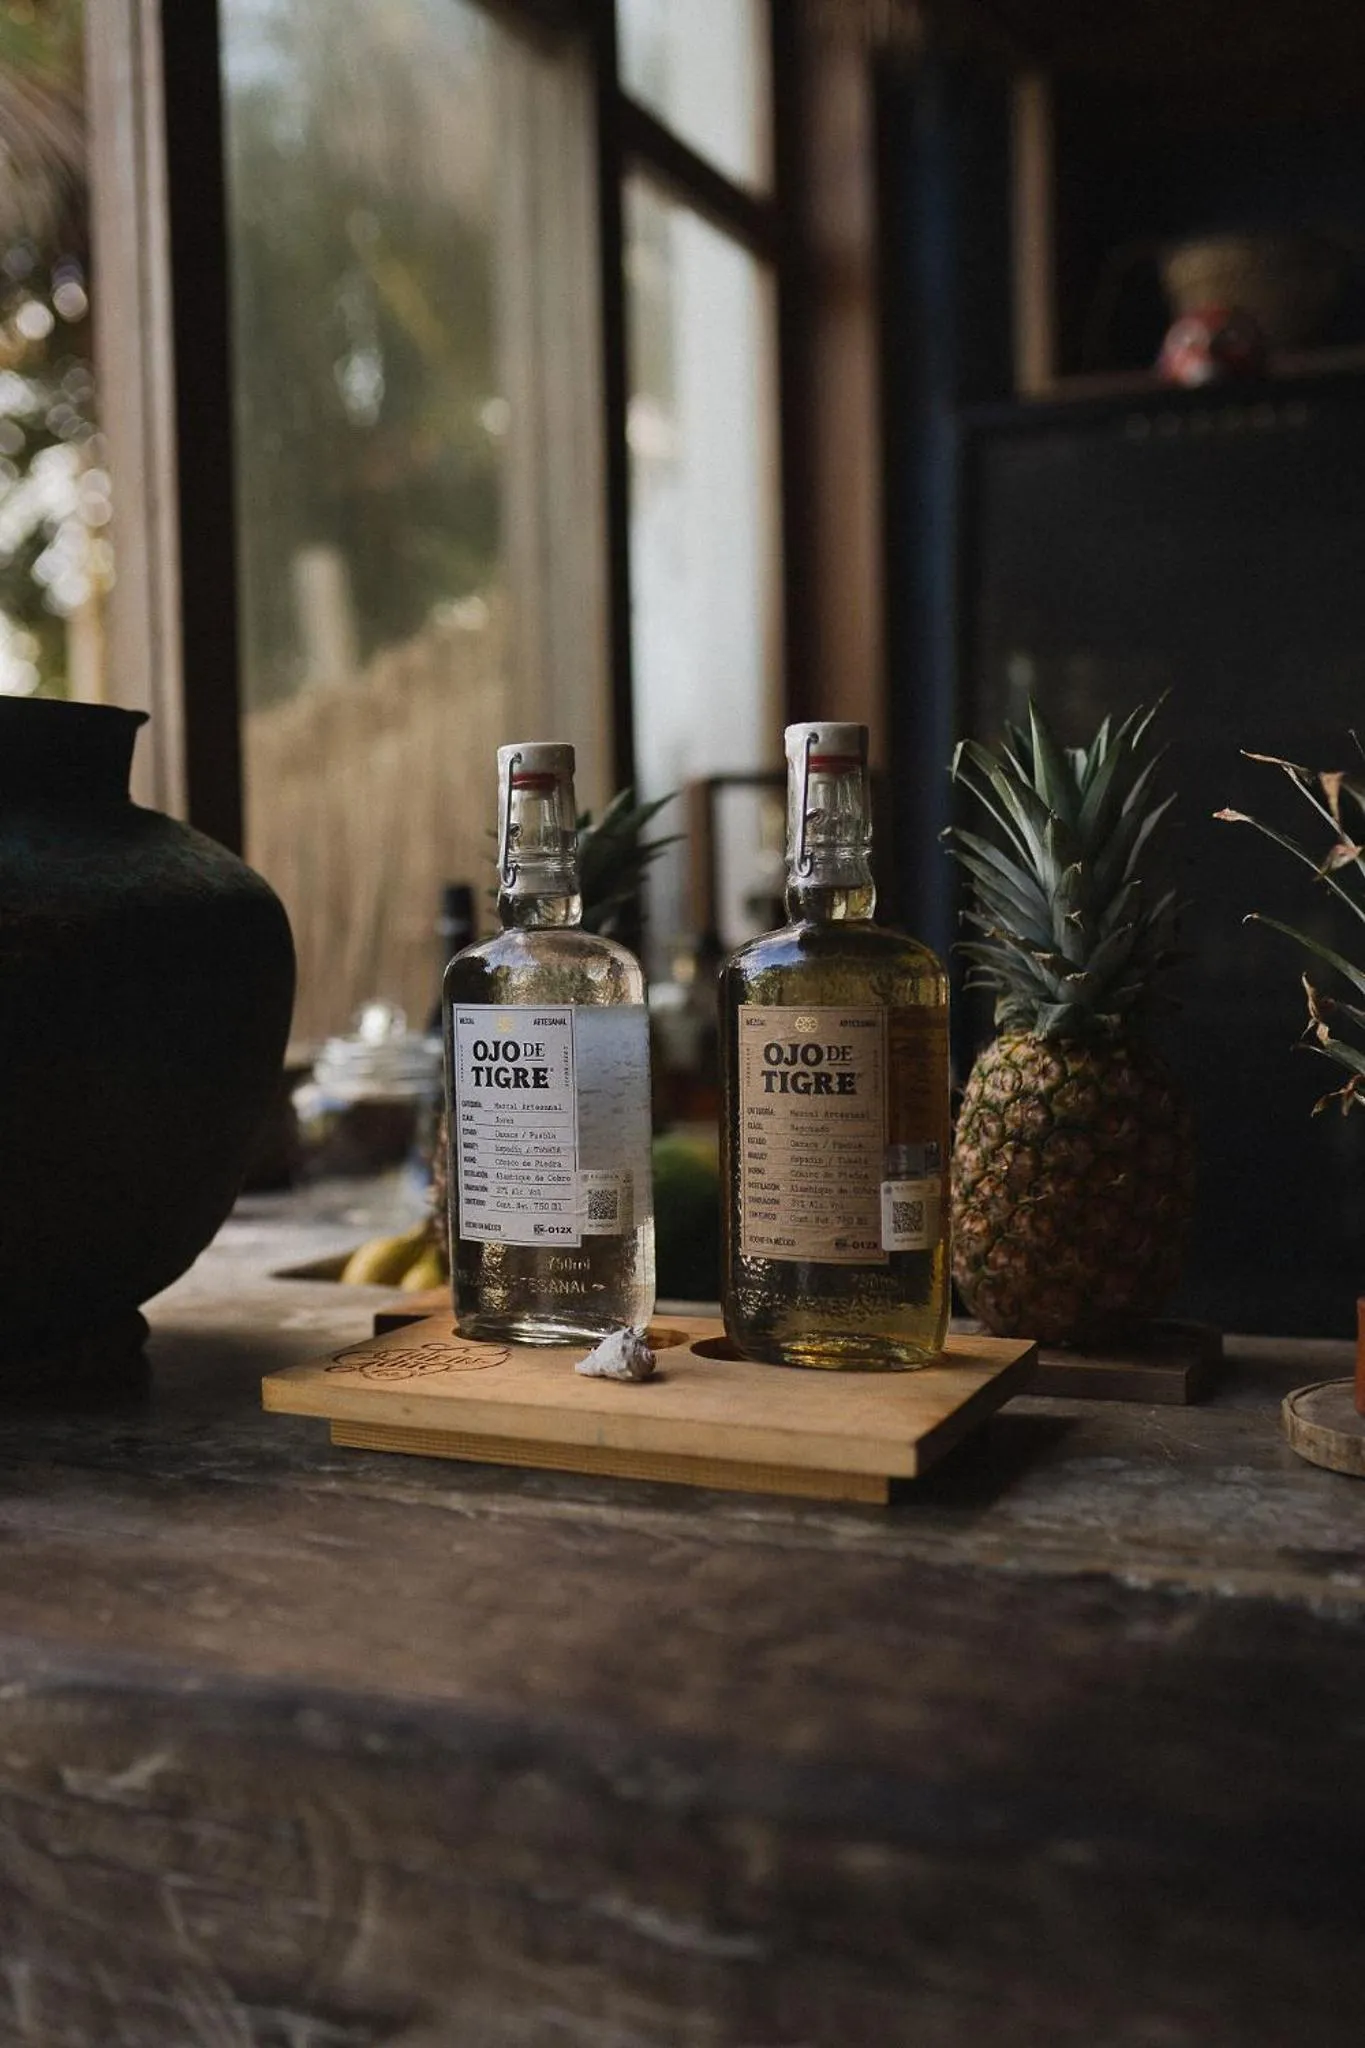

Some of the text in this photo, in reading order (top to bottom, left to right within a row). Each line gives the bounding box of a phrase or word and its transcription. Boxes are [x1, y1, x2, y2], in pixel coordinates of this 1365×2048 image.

[533, 1017, 568, 1026] ARTESANAL
[473, 1040, 545, 1062] OJO DE
[764, 1042, 853, 1067] OJO DE
[471, 1066, 550, 1089] TIGRE
[761, 1070, 857, 1095] TIGRE
[534, 1202, 549, 1210] 750
